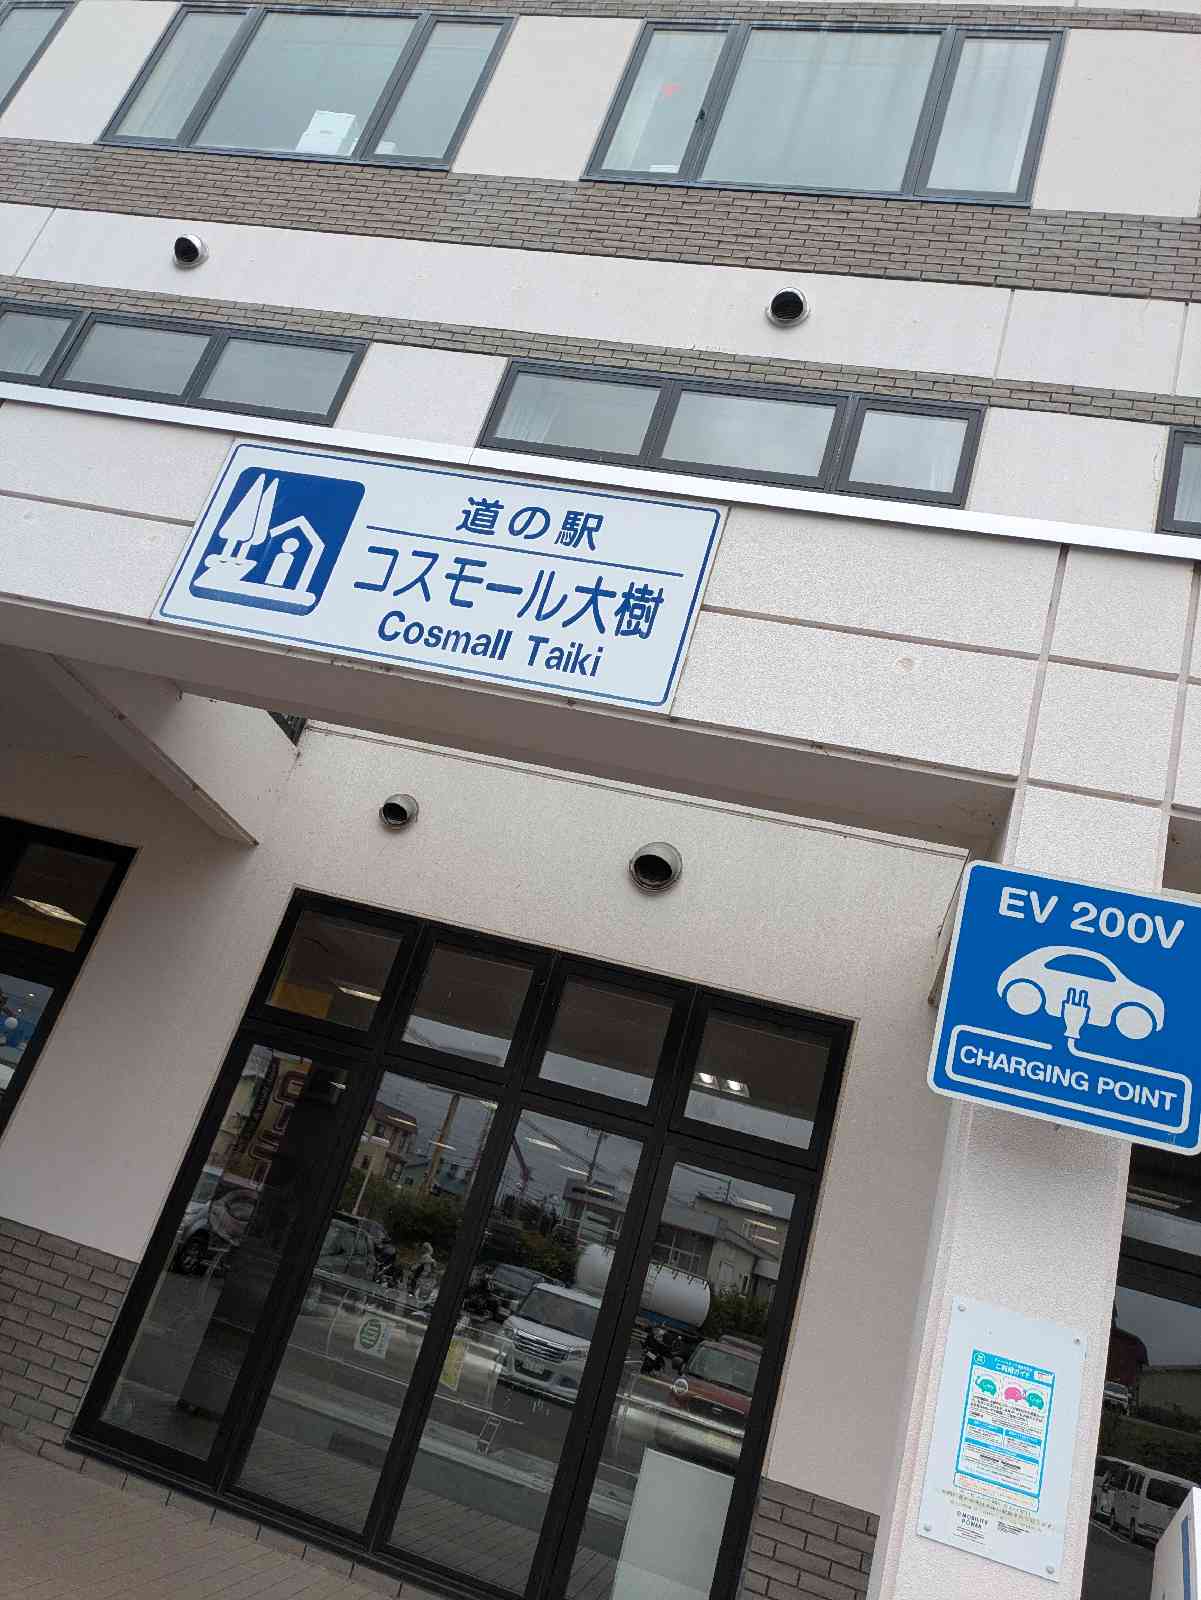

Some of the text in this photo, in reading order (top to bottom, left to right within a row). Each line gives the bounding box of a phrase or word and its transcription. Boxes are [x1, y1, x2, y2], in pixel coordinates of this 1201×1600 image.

[457, 497, 604, 550] 道の駅
[354, 545, 664, 639] コスモール大樹
[377, 611, 604, 676] Cosmall Taiki
[998, 886, 1184, 949] EV 200V
[960, 1045, 1177, 1111] CHARGING POINT
